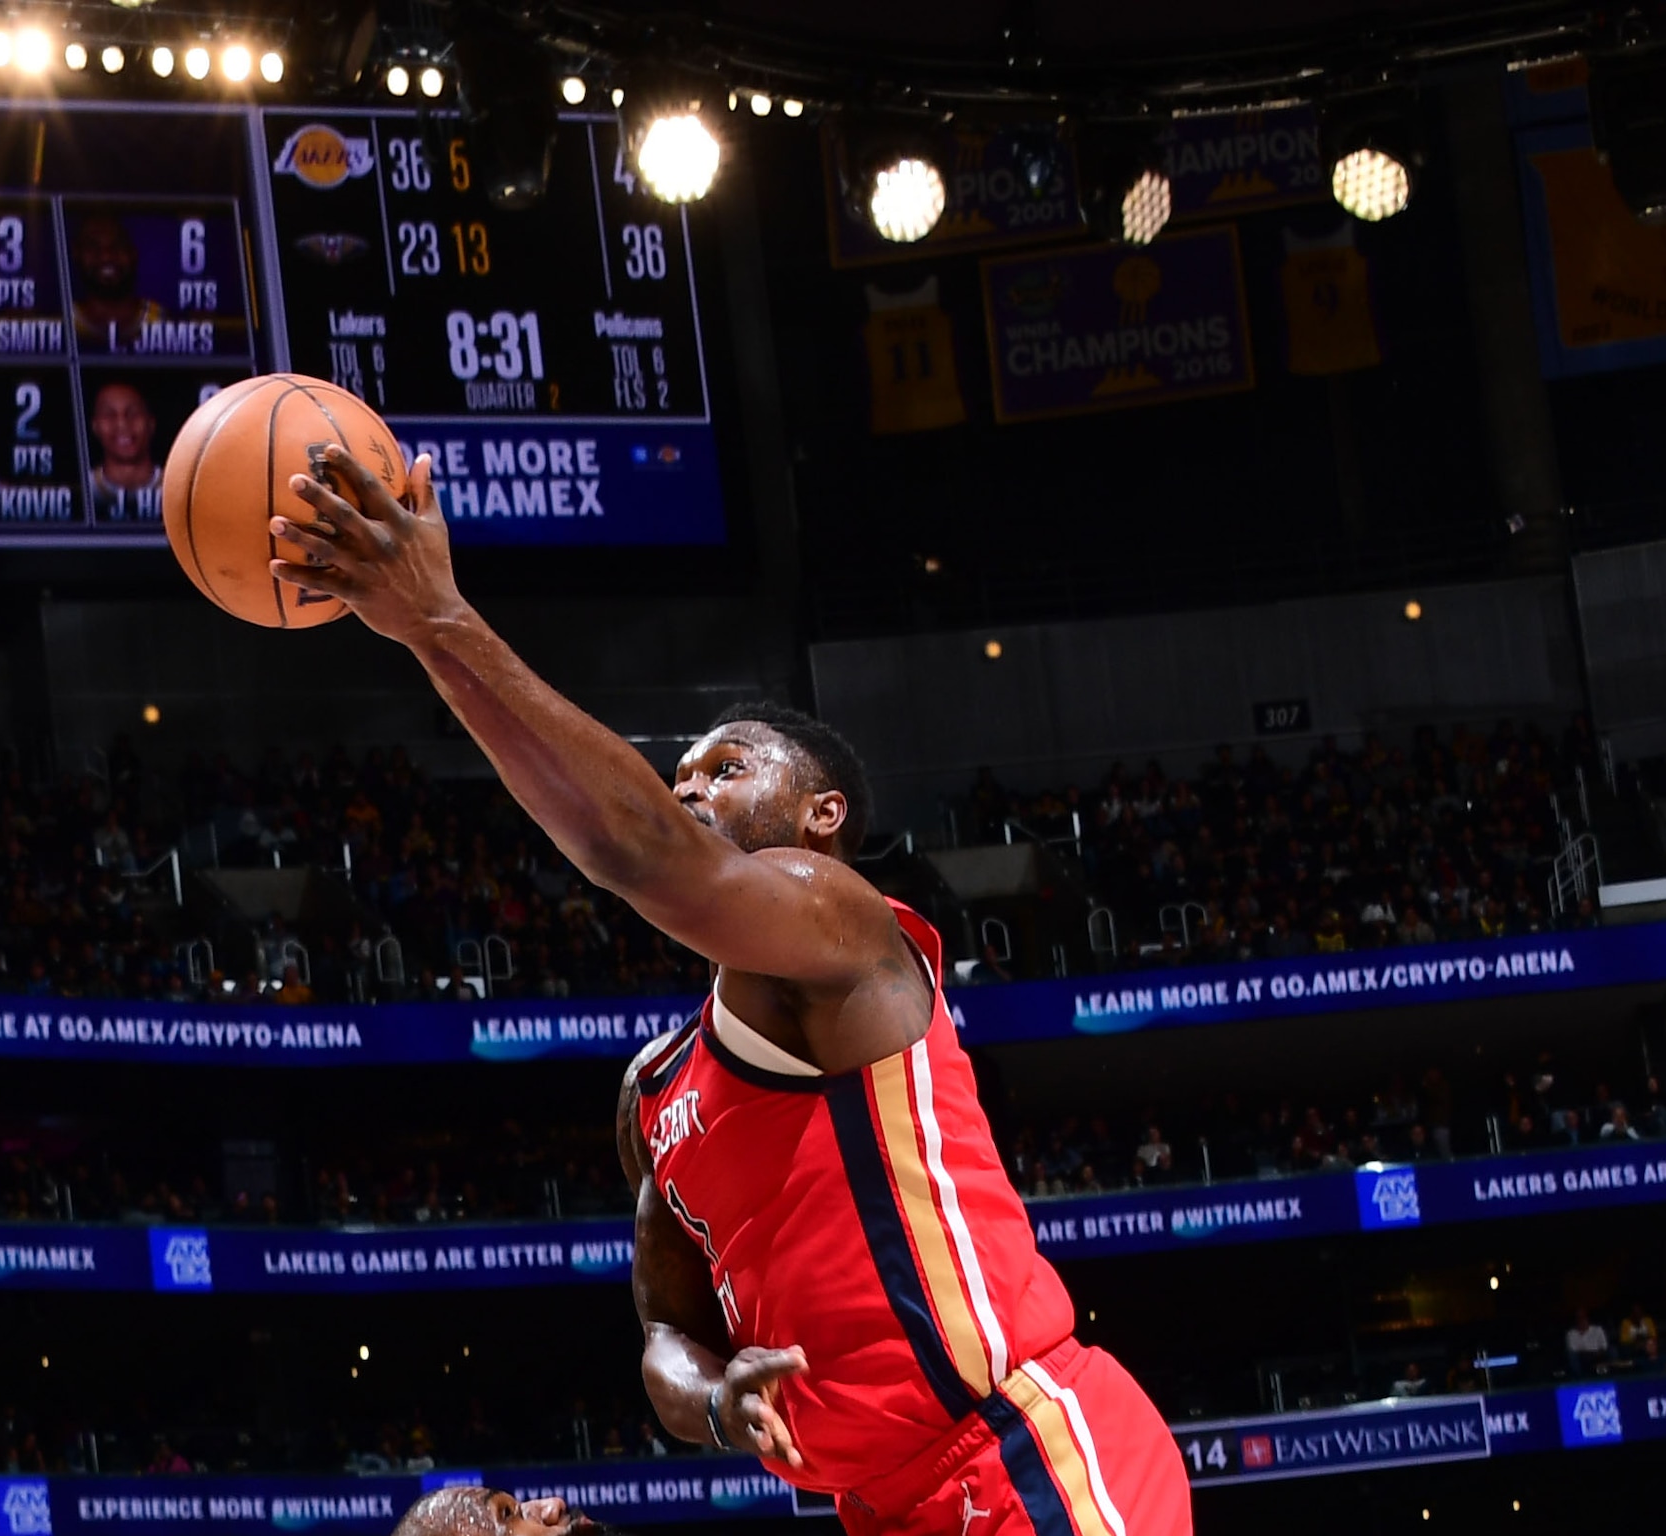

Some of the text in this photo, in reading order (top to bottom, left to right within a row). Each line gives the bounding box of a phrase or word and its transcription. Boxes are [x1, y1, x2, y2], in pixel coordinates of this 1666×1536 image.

[389, 139, 430, 190] 36
[0, 217, 22, 268] 3
[182, 220, 204, 270] 6
[399, 223, 489, 274] 23 13
[623, 224, 665, 278] 36
[180, 281, 216, 307] PTS
[133, 322, 213, 353] JAMES
[329, 311, 385, 335] Lakers
[447, 311, 543, 379] 8:31
[594, 312, 662, 337] Pelicans
[1007, 317, 1231, 378] CHAMPIONS
[1172, 352, 1233, 382] 2016
[16, 384, 40, 437] 2
[14, 446, 52, 471] PTS
[483, 440, 599, 474] MORE
[1263, 703, 1300, 728] 307
[1076, 950, 1574, 1016] LEARN MORE AT GO.AMEX/CRYPTO-ARENA
[1475, 1174, 1557, 1199] LAKERS
[1564, 1166, 1637, 1190] GAMES
[1187, 1439, 1226, 1470] 14
[1409, 1419, 1478, 1447] BANK
